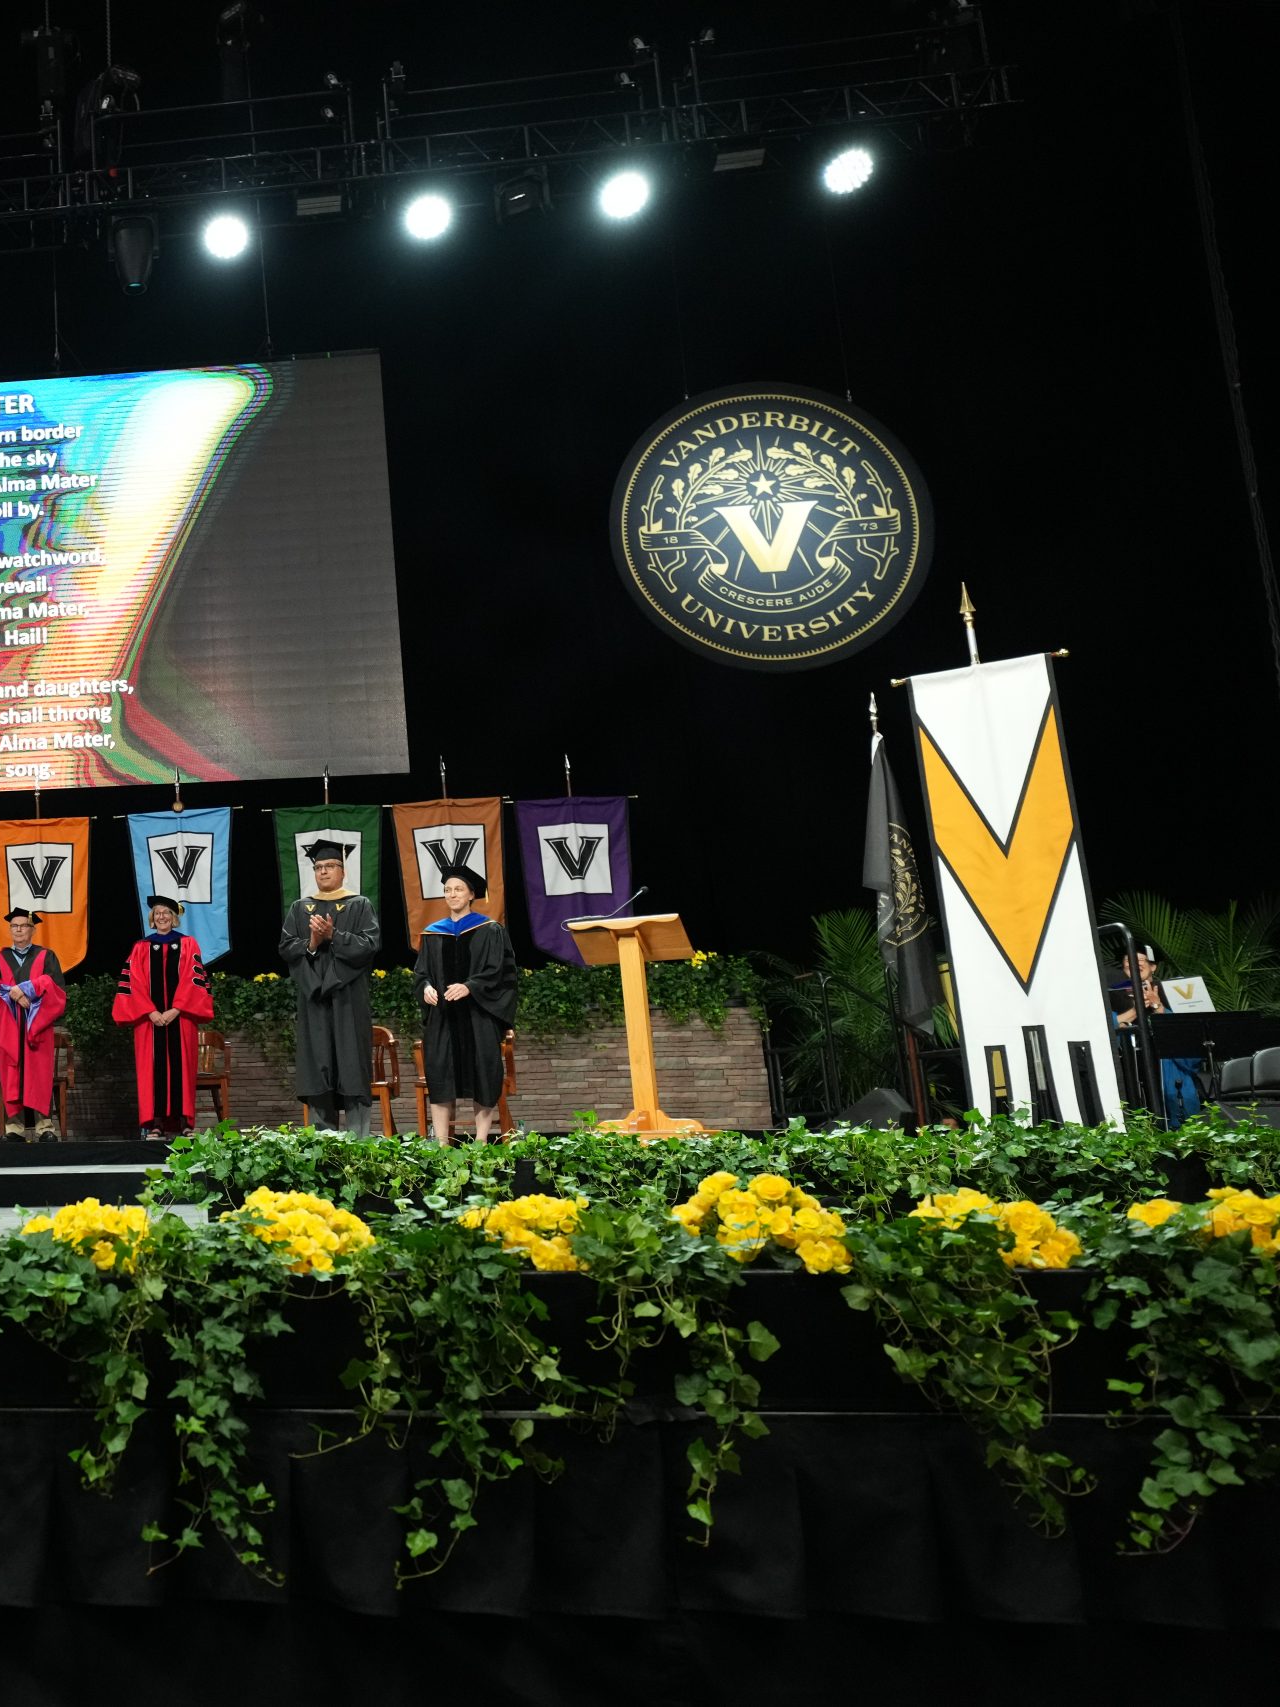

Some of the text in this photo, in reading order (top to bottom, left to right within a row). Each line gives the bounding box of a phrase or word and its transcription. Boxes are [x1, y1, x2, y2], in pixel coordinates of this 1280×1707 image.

[21, 423, 84, 441] border
[659, 411, 861, 469] VANDERBILT
[26, 450, 57, 468] sky
[41, 474, 98, 490] Mater
[17, 501, 45, 520] by.
[662, 521, 879, 545] 18 73
[712, 500, 820, 573] V
[719, 579, 834, 607] CRESCERE AUDE
[679, 580, 878, 642] UNIVERSITY
[33, 677, 135, 699] daughters,
[0, 706, 43, 724] shall
[48, 705, 113, 723] throng
[53, 732, 116, 749] Mater,
[5, 762, 56, 780] song.
[420, 838, 480, 868] V
[544, 836, 605, 880] V
[11, 856, 68, 899] V
[154, 845, 206, 889] V
[1172, 983, 1195, 1000] V
